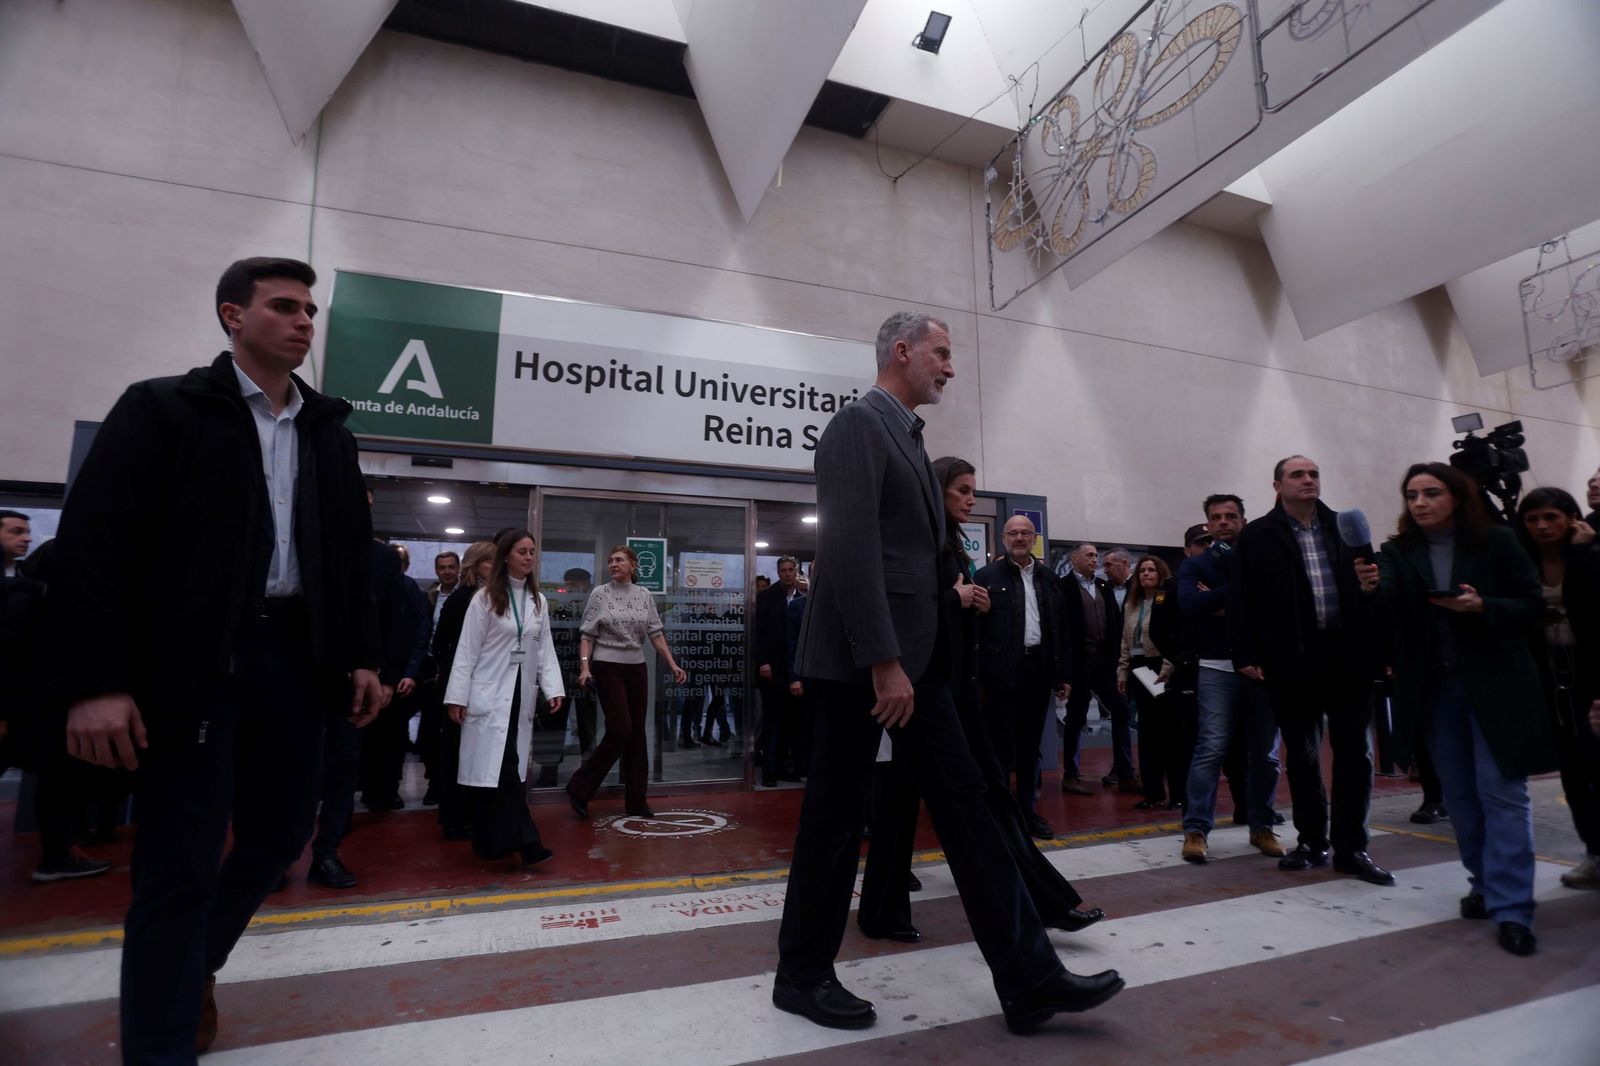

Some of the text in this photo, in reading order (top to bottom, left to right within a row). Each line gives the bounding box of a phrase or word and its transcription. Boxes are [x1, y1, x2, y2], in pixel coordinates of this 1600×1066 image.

[514, 350, 859, 414] Hospital Universitari
[342, 396, 480, 421] unta de Andalucía
[703, 414, 820, 451] Reina S
[680, 657, 732, 671] hospital
